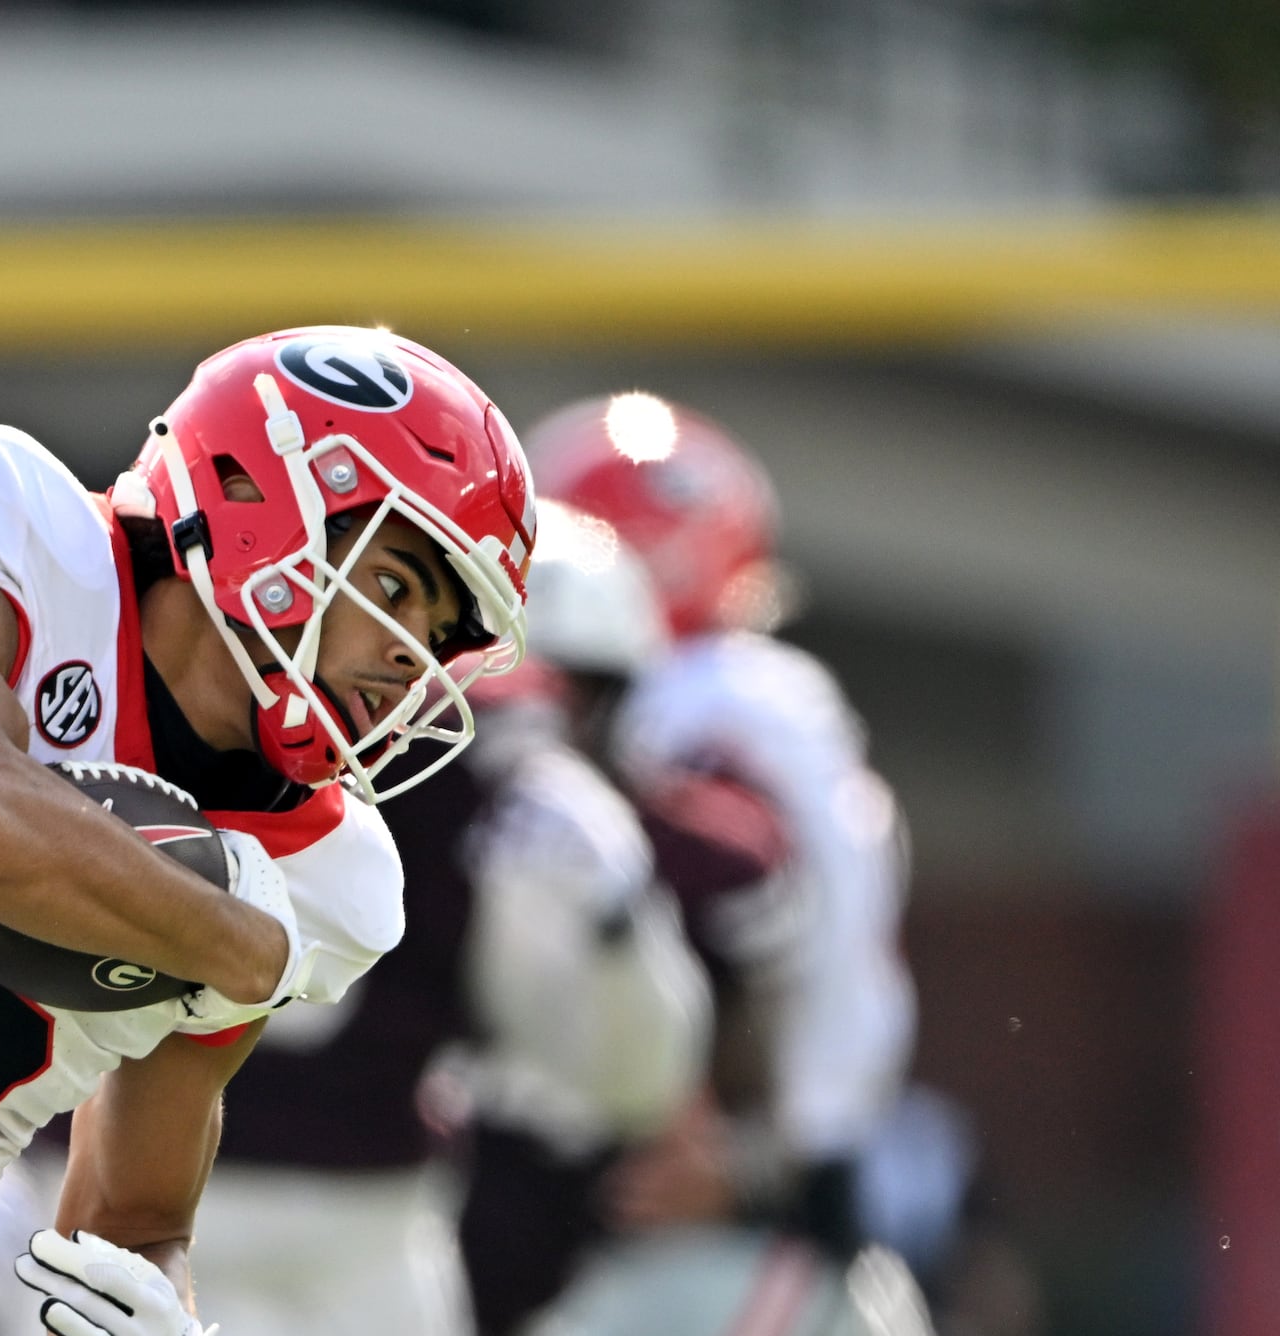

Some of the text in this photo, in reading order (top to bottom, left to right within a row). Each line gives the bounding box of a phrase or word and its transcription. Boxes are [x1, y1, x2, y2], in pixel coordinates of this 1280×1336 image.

[278, 339, 410, 410] G
[40, 665, 99, 742] SEC
[92, 957, 156, 991] G
